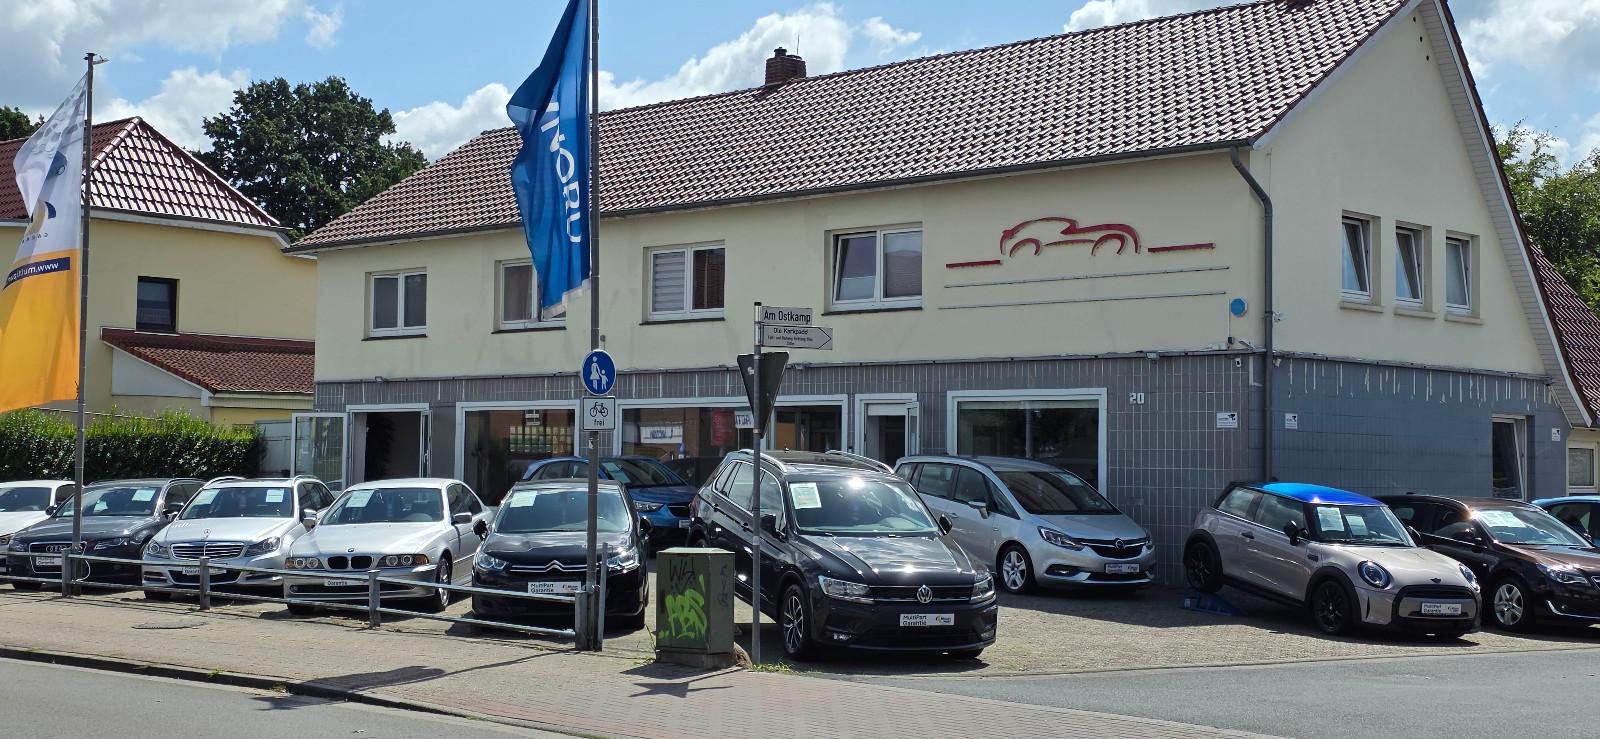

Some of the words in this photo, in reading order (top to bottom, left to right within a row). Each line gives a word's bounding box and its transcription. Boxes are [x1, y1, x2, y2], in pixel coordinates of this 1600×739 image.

[763, 309, 776, 321] Am
[778, 310, 811, 325] Ostkamp
[1129, 392, 1145, 405] 20
[593, 418, 605, 427] frei
